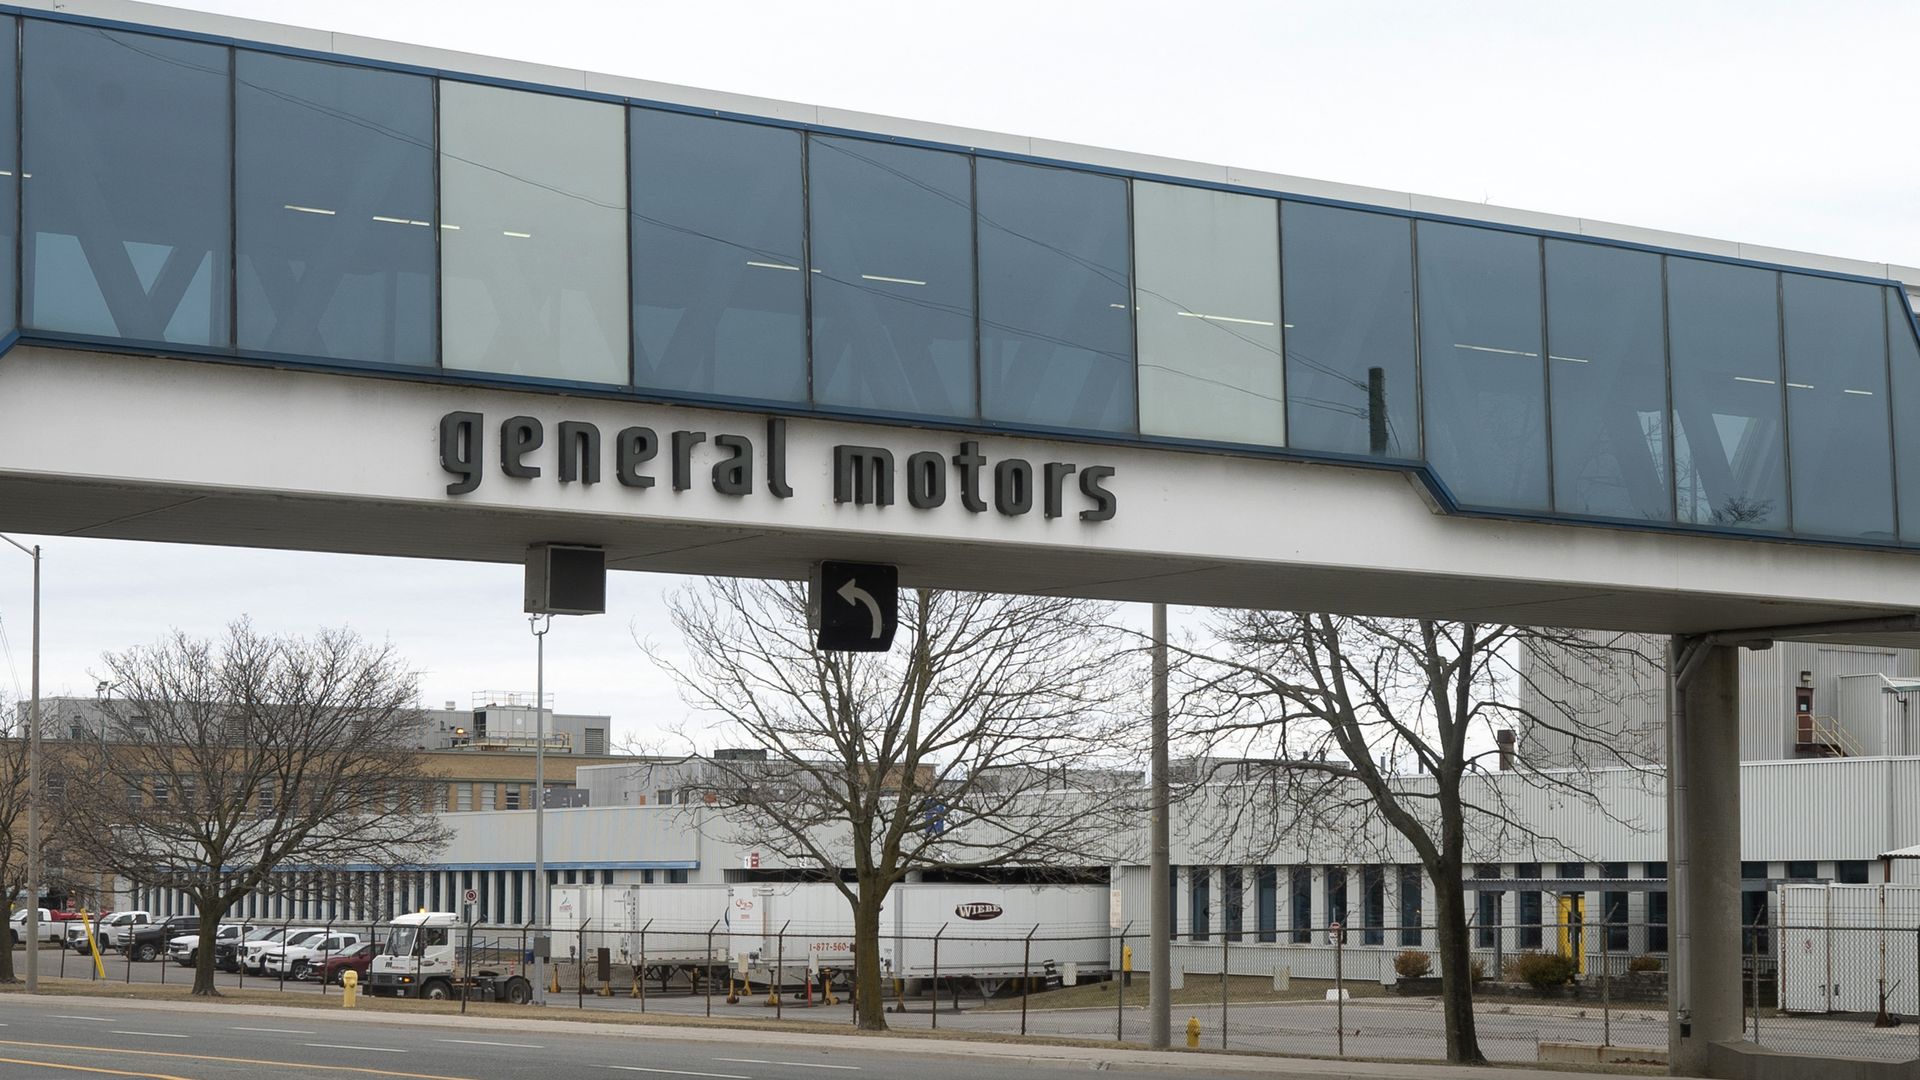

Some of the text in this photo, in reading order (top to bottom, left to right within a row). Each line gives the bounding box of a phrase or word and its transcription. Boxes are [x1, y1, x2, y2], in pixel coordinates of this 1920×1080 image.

[439, 410, 1117, 522] general motors
[957, 904, 1001, 918] WIEBE
[809, 942, 851, 952] 1-877-560-
